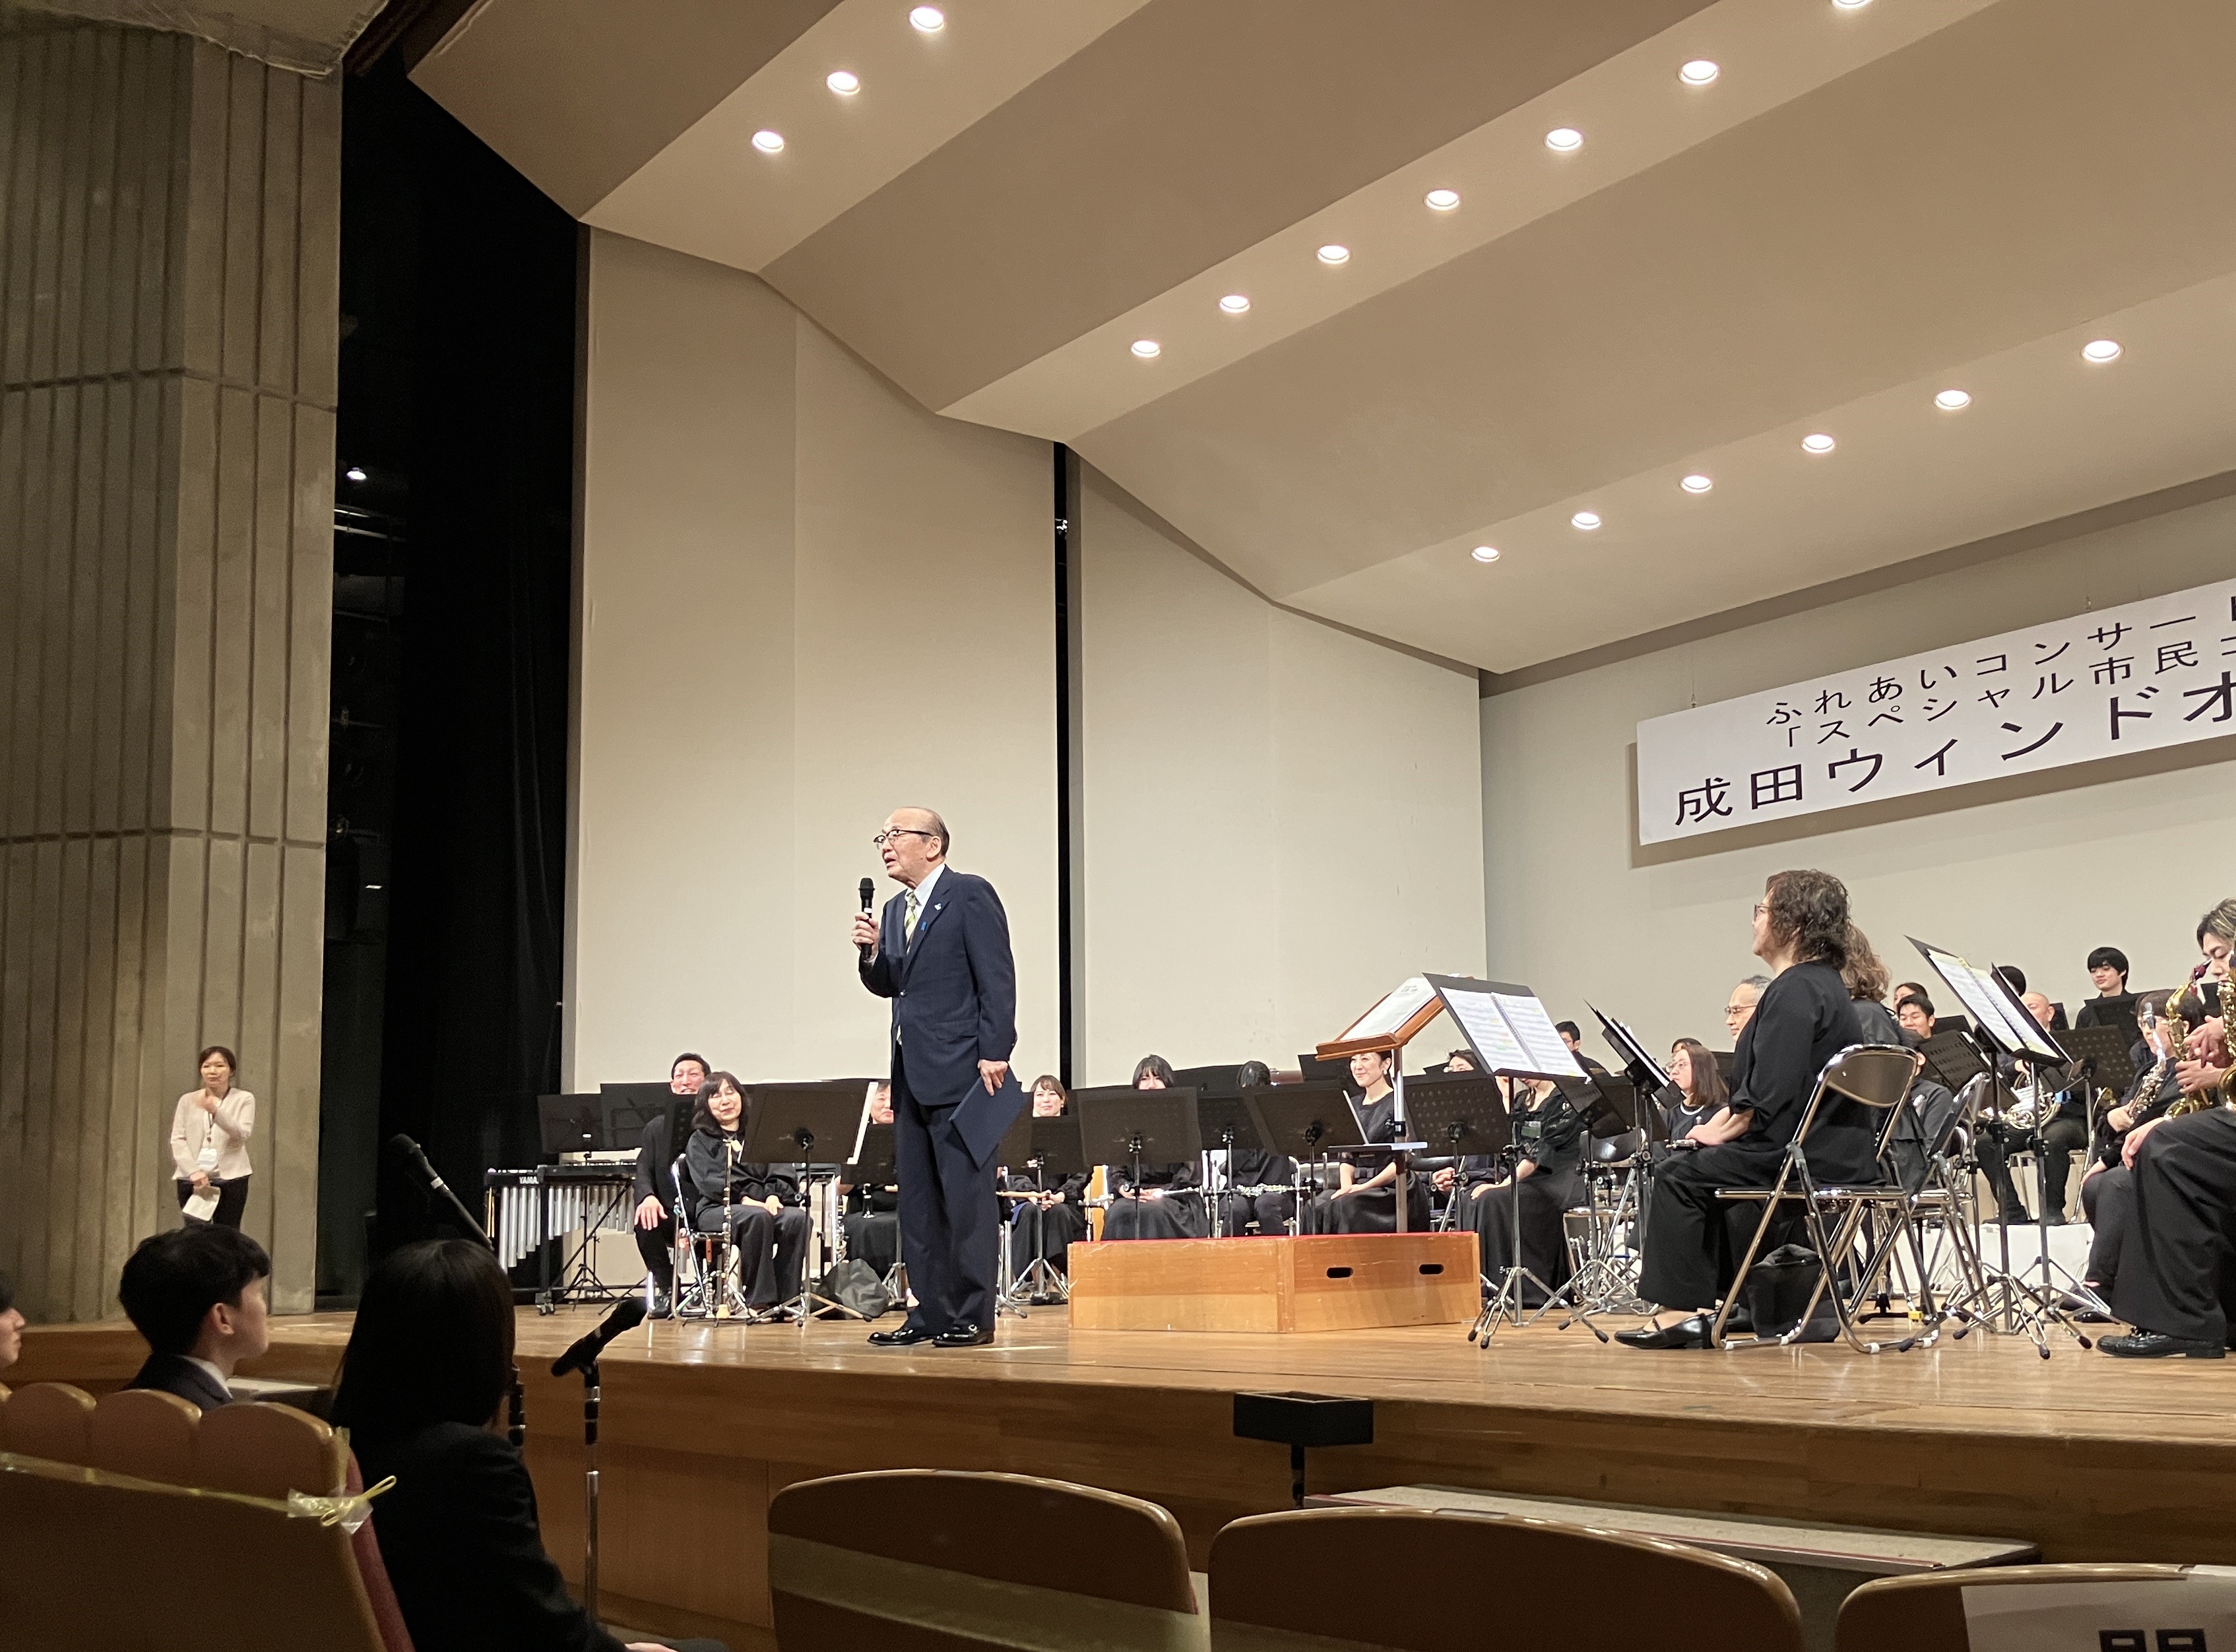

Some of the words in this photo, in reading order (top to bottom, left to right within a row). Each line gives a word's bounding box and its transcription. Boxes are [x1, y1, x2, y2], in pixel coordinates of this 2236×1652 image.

[1766, 596, 2236, 725] ふれあいコンサー
[1675, 670, 2236, 826] 成田ウィンドオ
